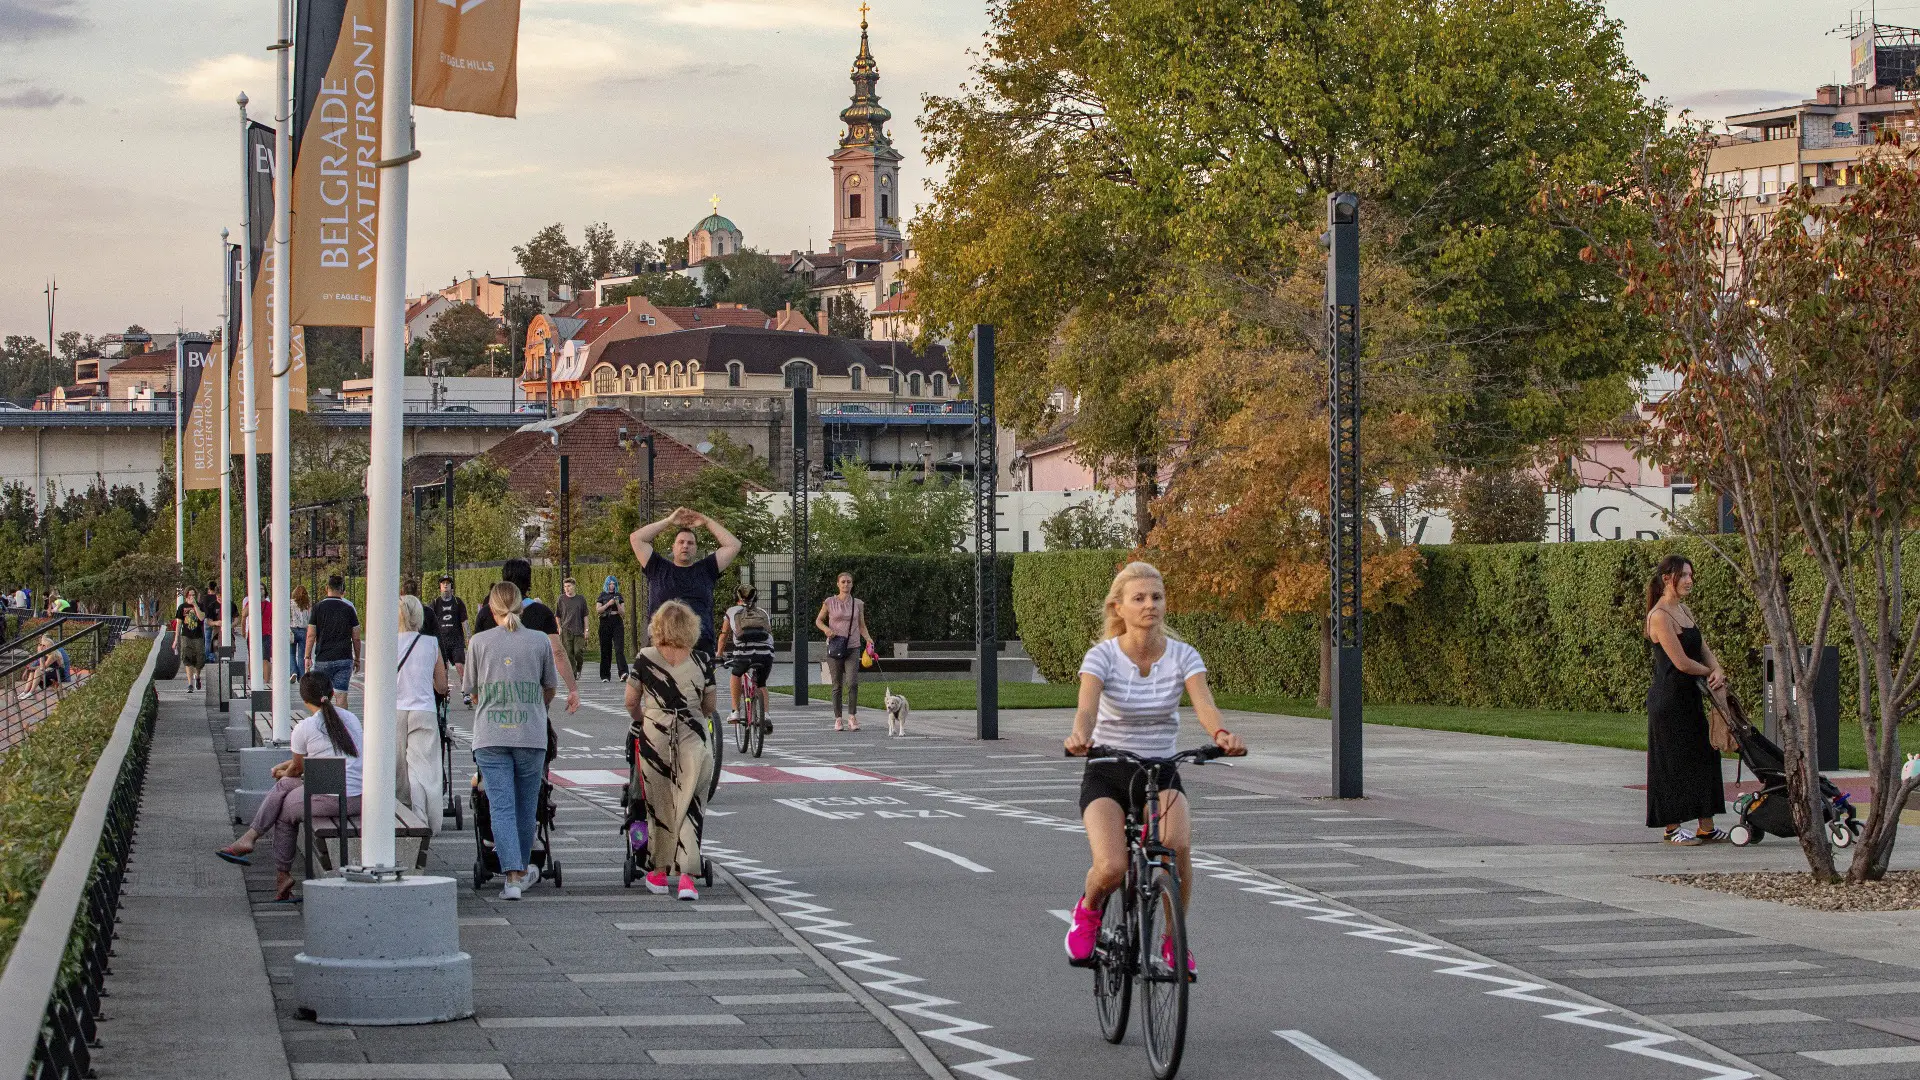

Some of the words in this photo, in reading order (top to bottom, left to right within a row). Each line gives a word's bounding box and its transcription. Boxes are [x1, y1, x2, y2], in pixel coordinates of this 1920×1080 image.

[467, 60, 495, 72] HILLS
[353, 15, 376, 270] WATERFRONT
[320, 77, 349, 268] BELGRADE
[335, 293, 360, 301] EAGLE
[188, 351, 217, 368] BW
[204, 380, 214, 469] WATERFRONT
